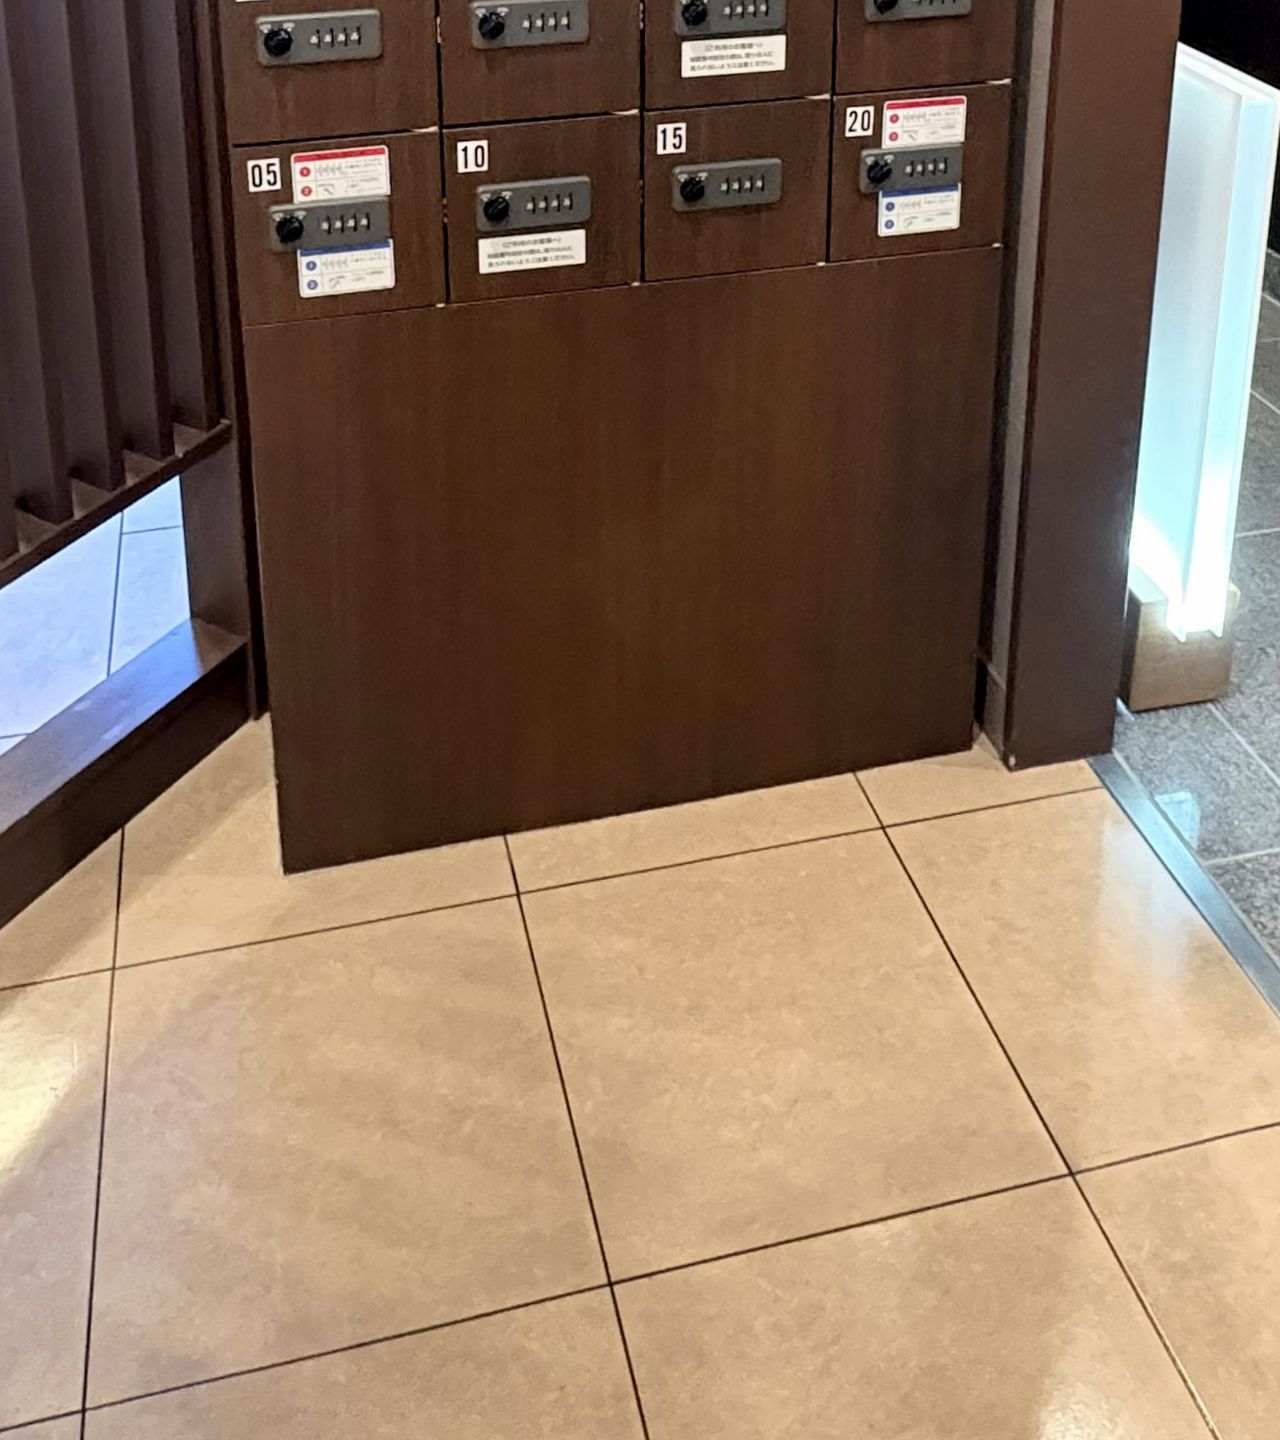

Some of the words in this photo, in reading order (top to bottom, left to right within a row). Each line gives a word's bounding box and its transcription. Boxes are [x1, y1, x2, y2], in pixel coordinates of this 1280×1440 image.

[848, 110, 872, 133] 20
[661, 127, 682, 150] 15
[462, 145, 484, 169] 10
[252, 163, 277, 187] 05
